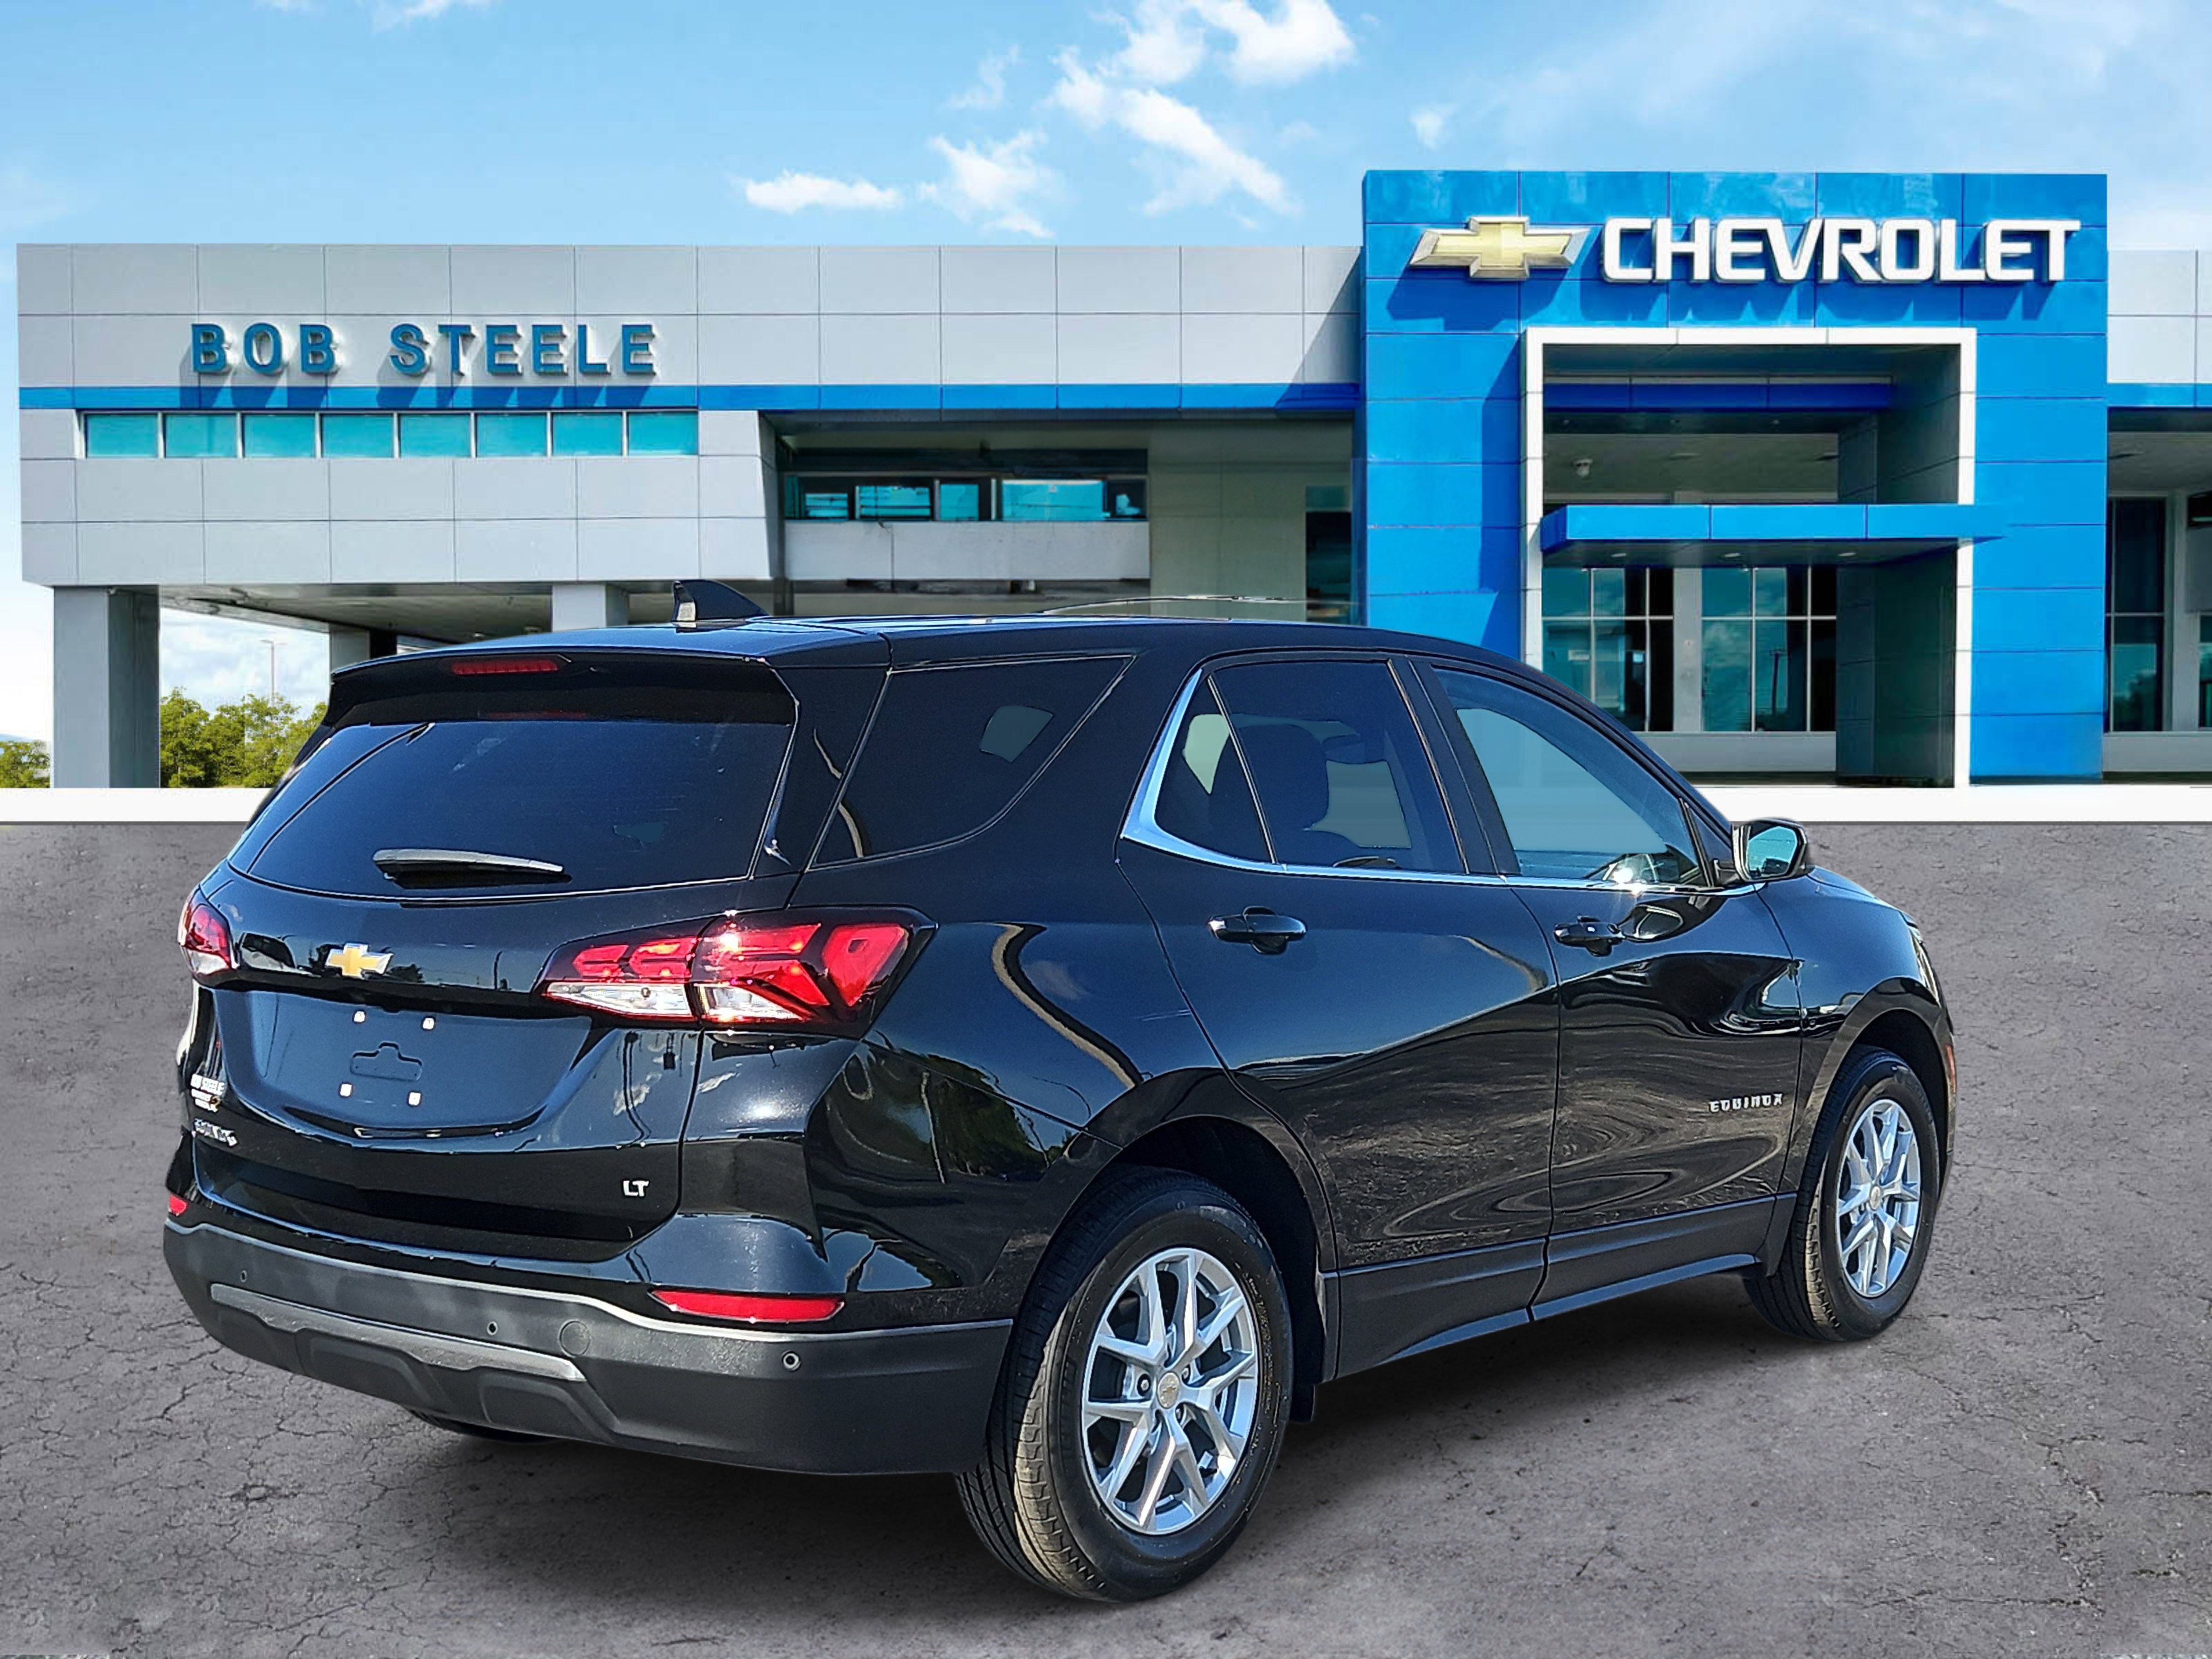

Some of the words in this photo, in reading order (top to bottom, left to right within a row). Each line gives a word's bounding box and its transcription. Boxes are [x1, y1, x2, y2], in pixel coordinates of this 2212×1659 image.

[1602, 218, 2081, 282] CHEVROLET
[191, 323, 338, 374] BOB
[390, 323, 656, 375] STEELE
[1709, 1093, 1783, 1113] EQUINOX
[623, 1181, 649, 1197] LT
